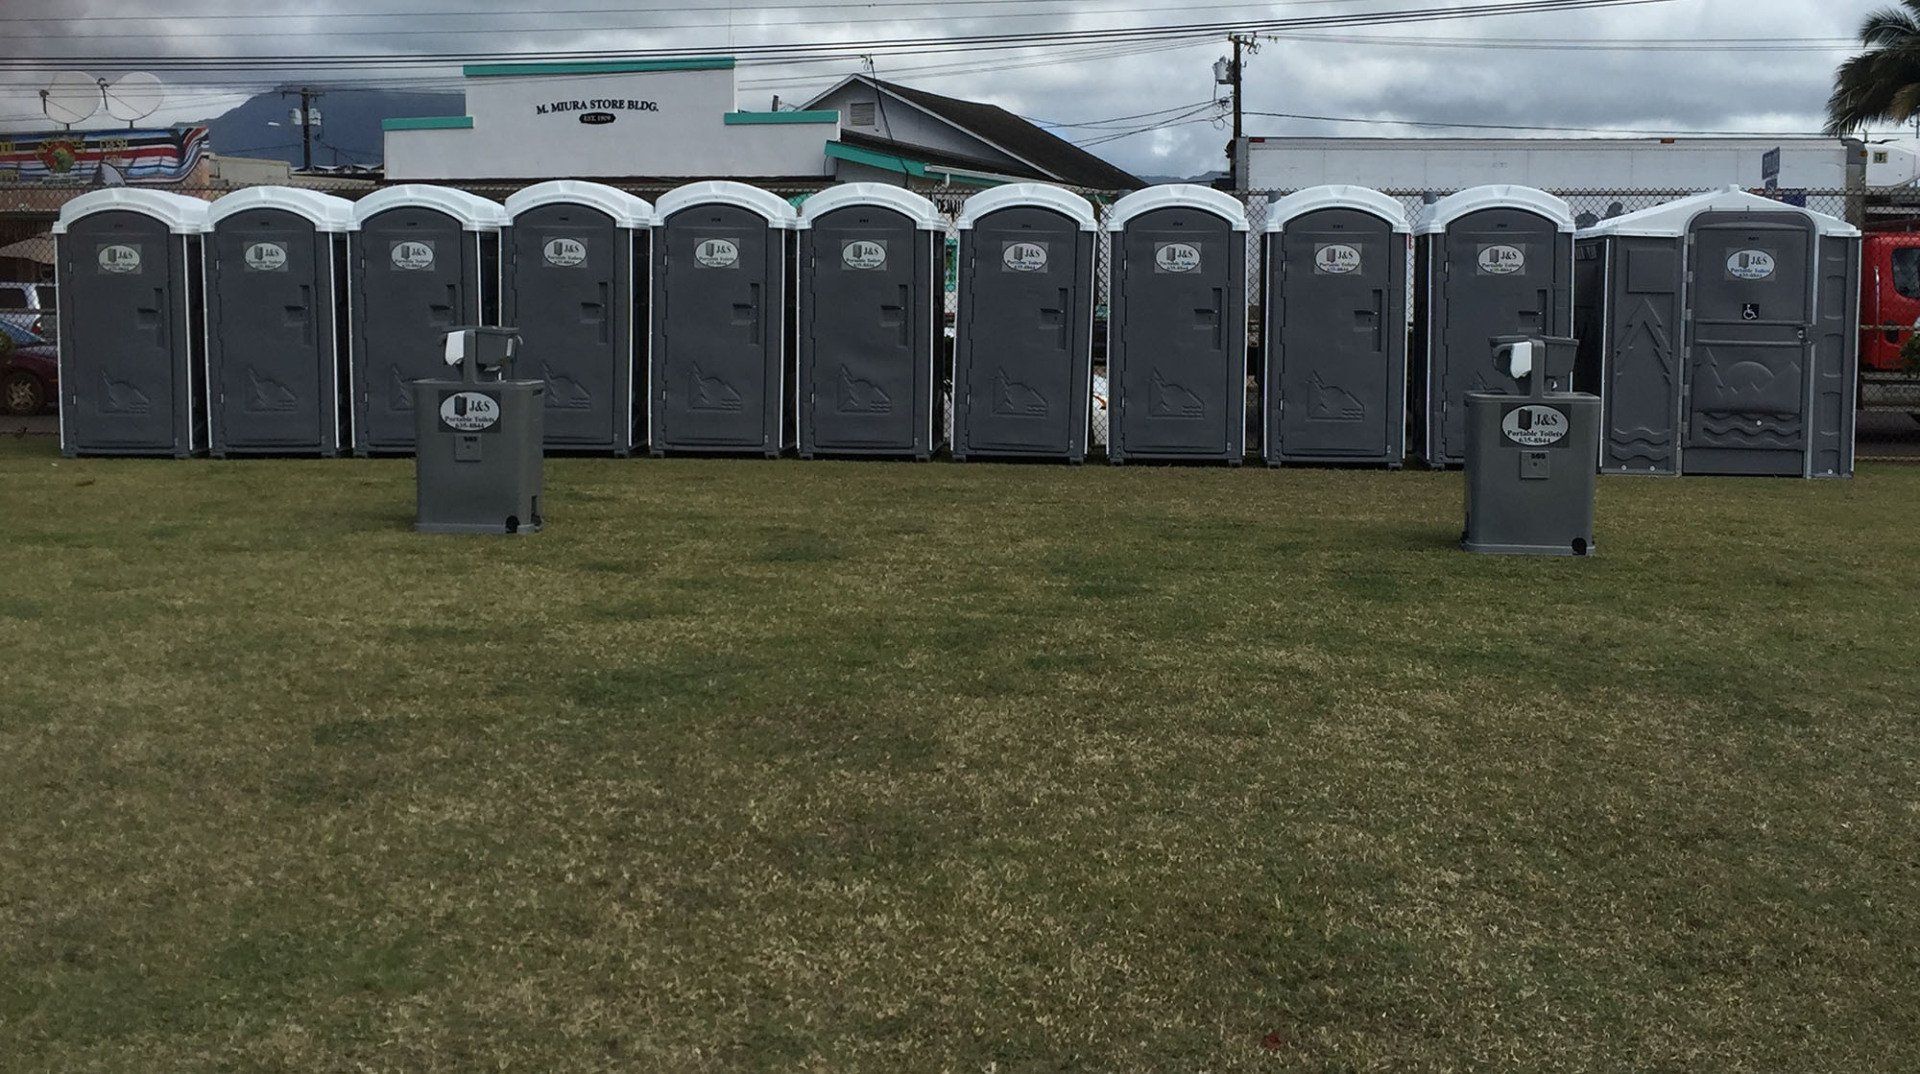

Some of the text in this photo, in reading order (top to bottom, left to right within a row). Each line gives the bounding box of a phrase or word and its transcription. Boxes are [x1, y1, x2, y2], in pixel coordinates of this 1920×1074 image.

[536, 99, 659, 115] M. MIURA STORE BLDG.
[716, 246, 731, 254] J&S
[864, 247, 879, 255] J&S
[1025, 249, 1040, 257] J&S
[1177, 249, 1192, 258] J&S
[1338, 250, 1353, 259] J&S
[1500, 251, 1517, 259] J&S
[1751, 256, 1767, 265] J&S
[468, 400, 490, 412] J&S
[1534, 414, 1558, 426] J&S
